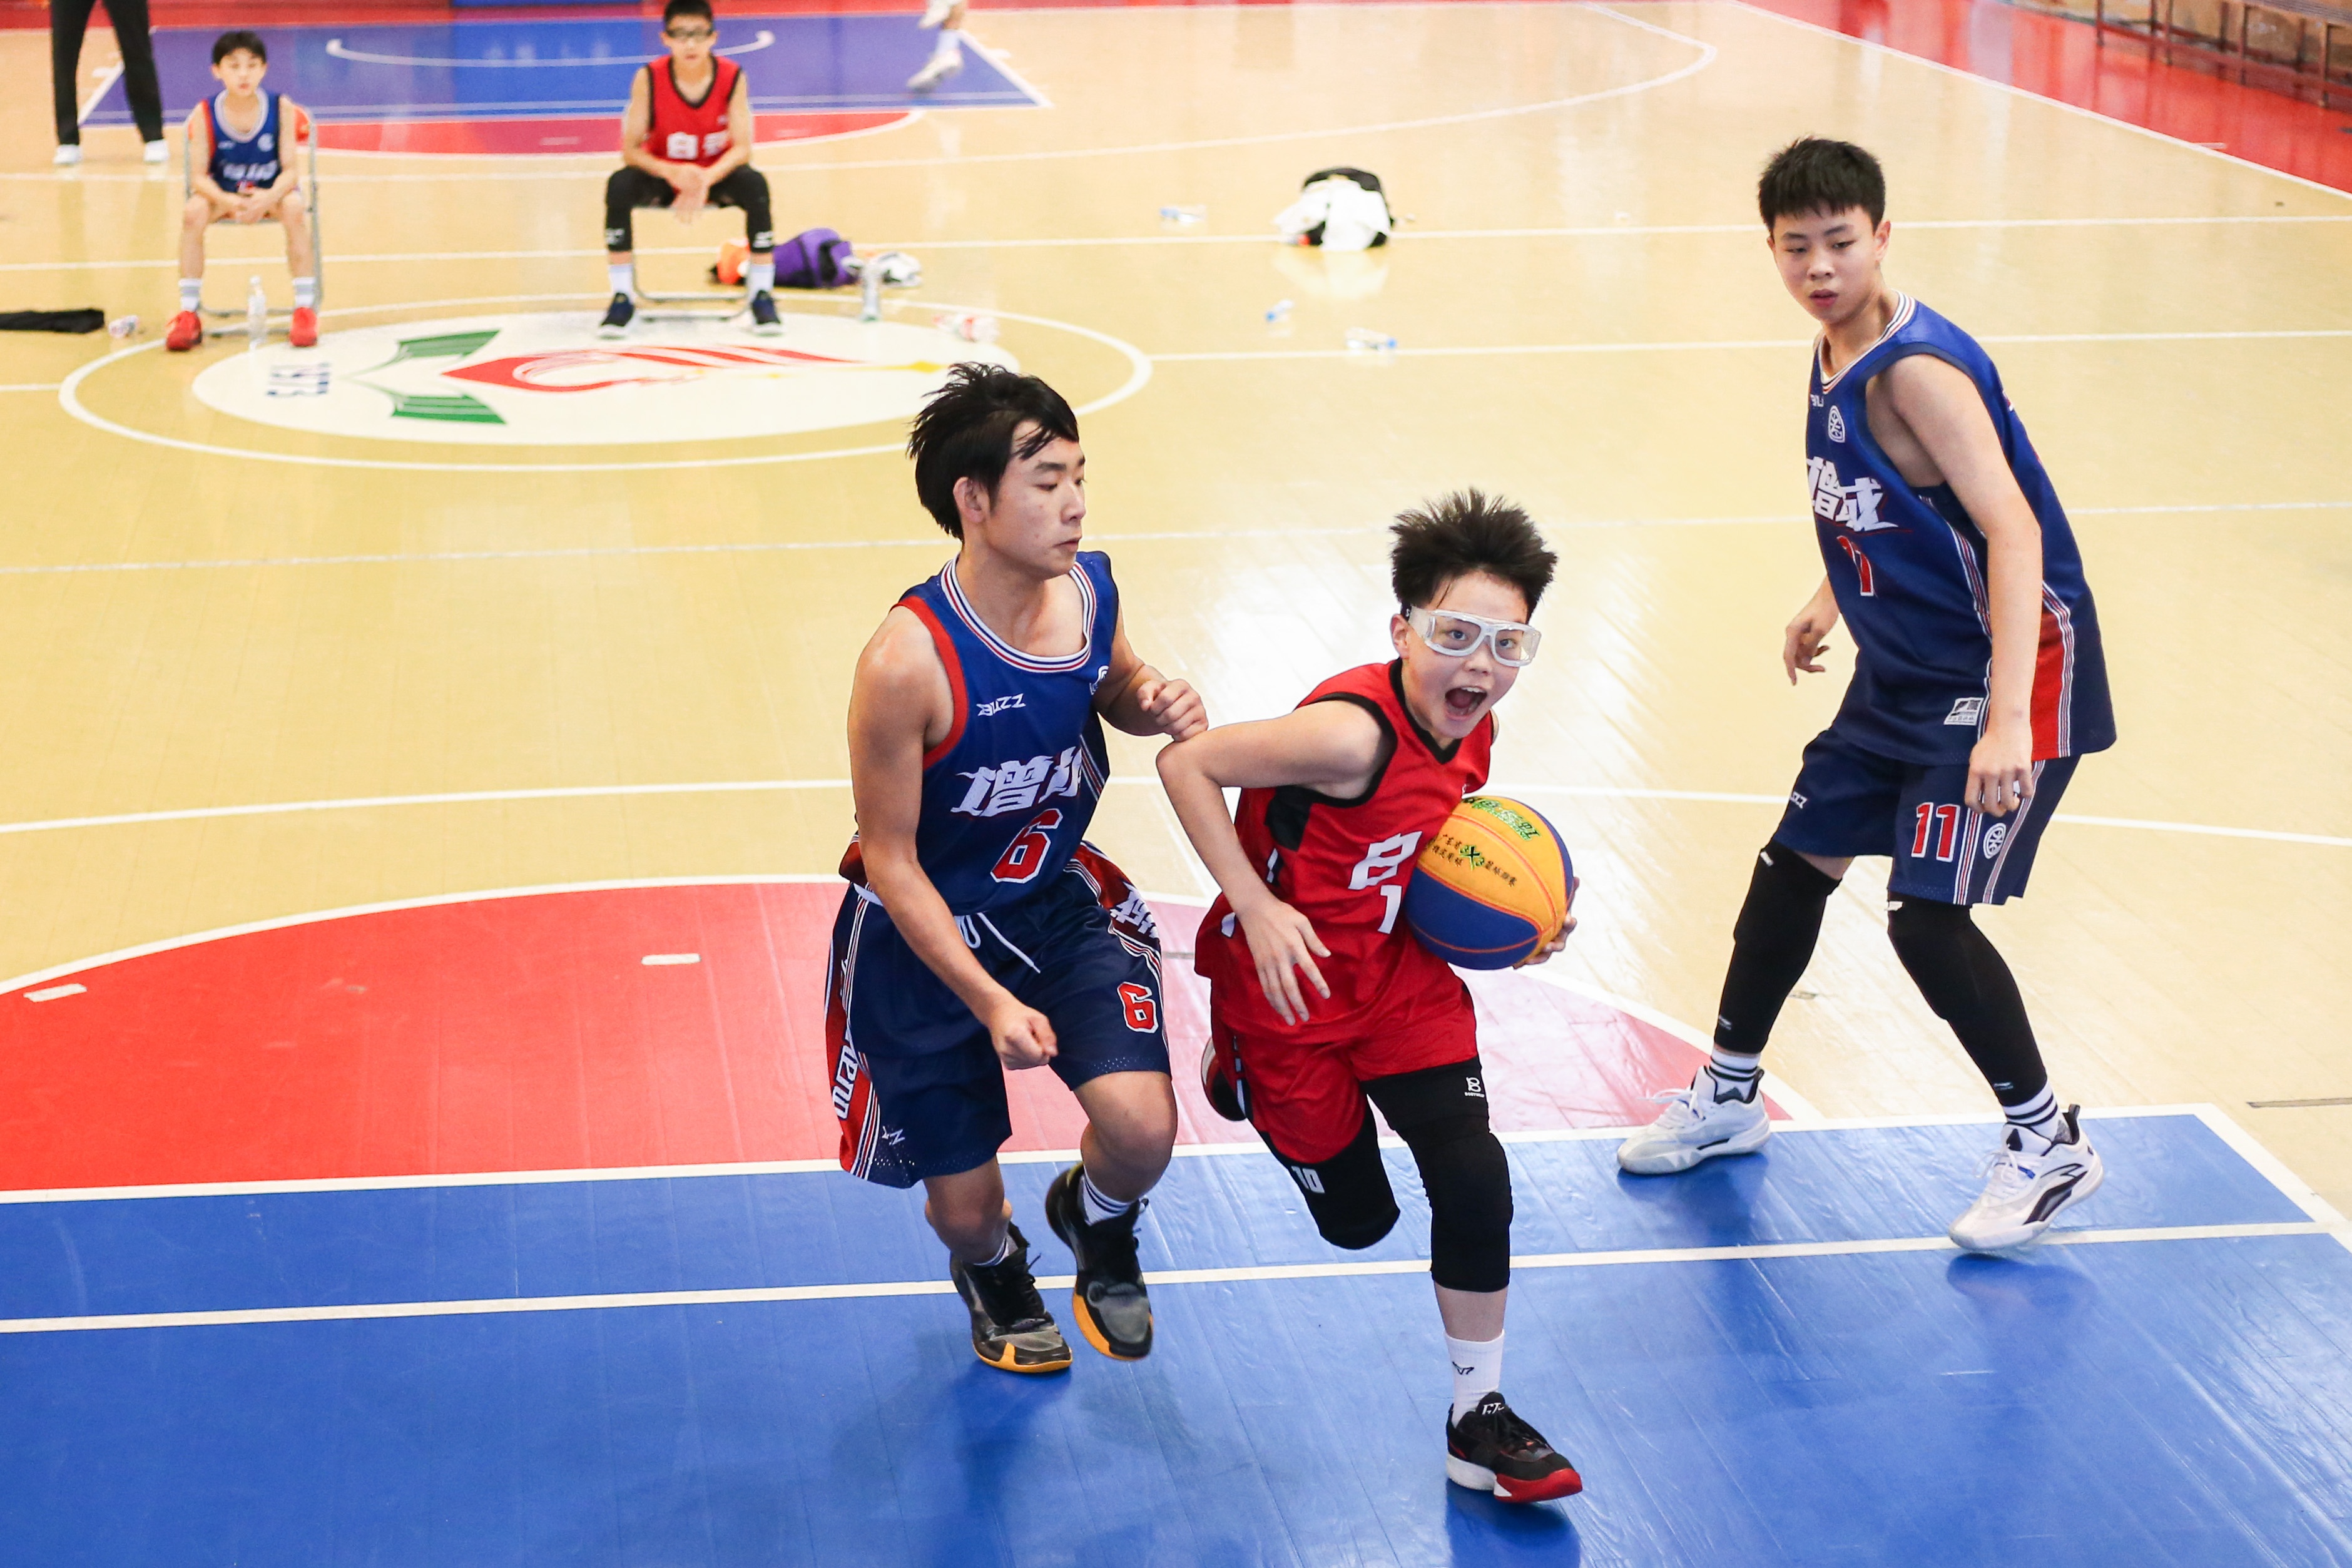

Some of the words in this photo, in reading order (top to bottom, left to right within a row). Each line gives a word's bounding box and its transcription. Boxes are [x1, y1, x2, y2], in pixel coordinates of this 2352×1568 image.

[976, 693, 1027, 716] BUZZ
[990, 808, 1064, 884] 6
[1911, 802, 1961, 863] 11
[1116, 982, 1159, 1034] 6
[1291, 1165, 1325, 1194] 10
